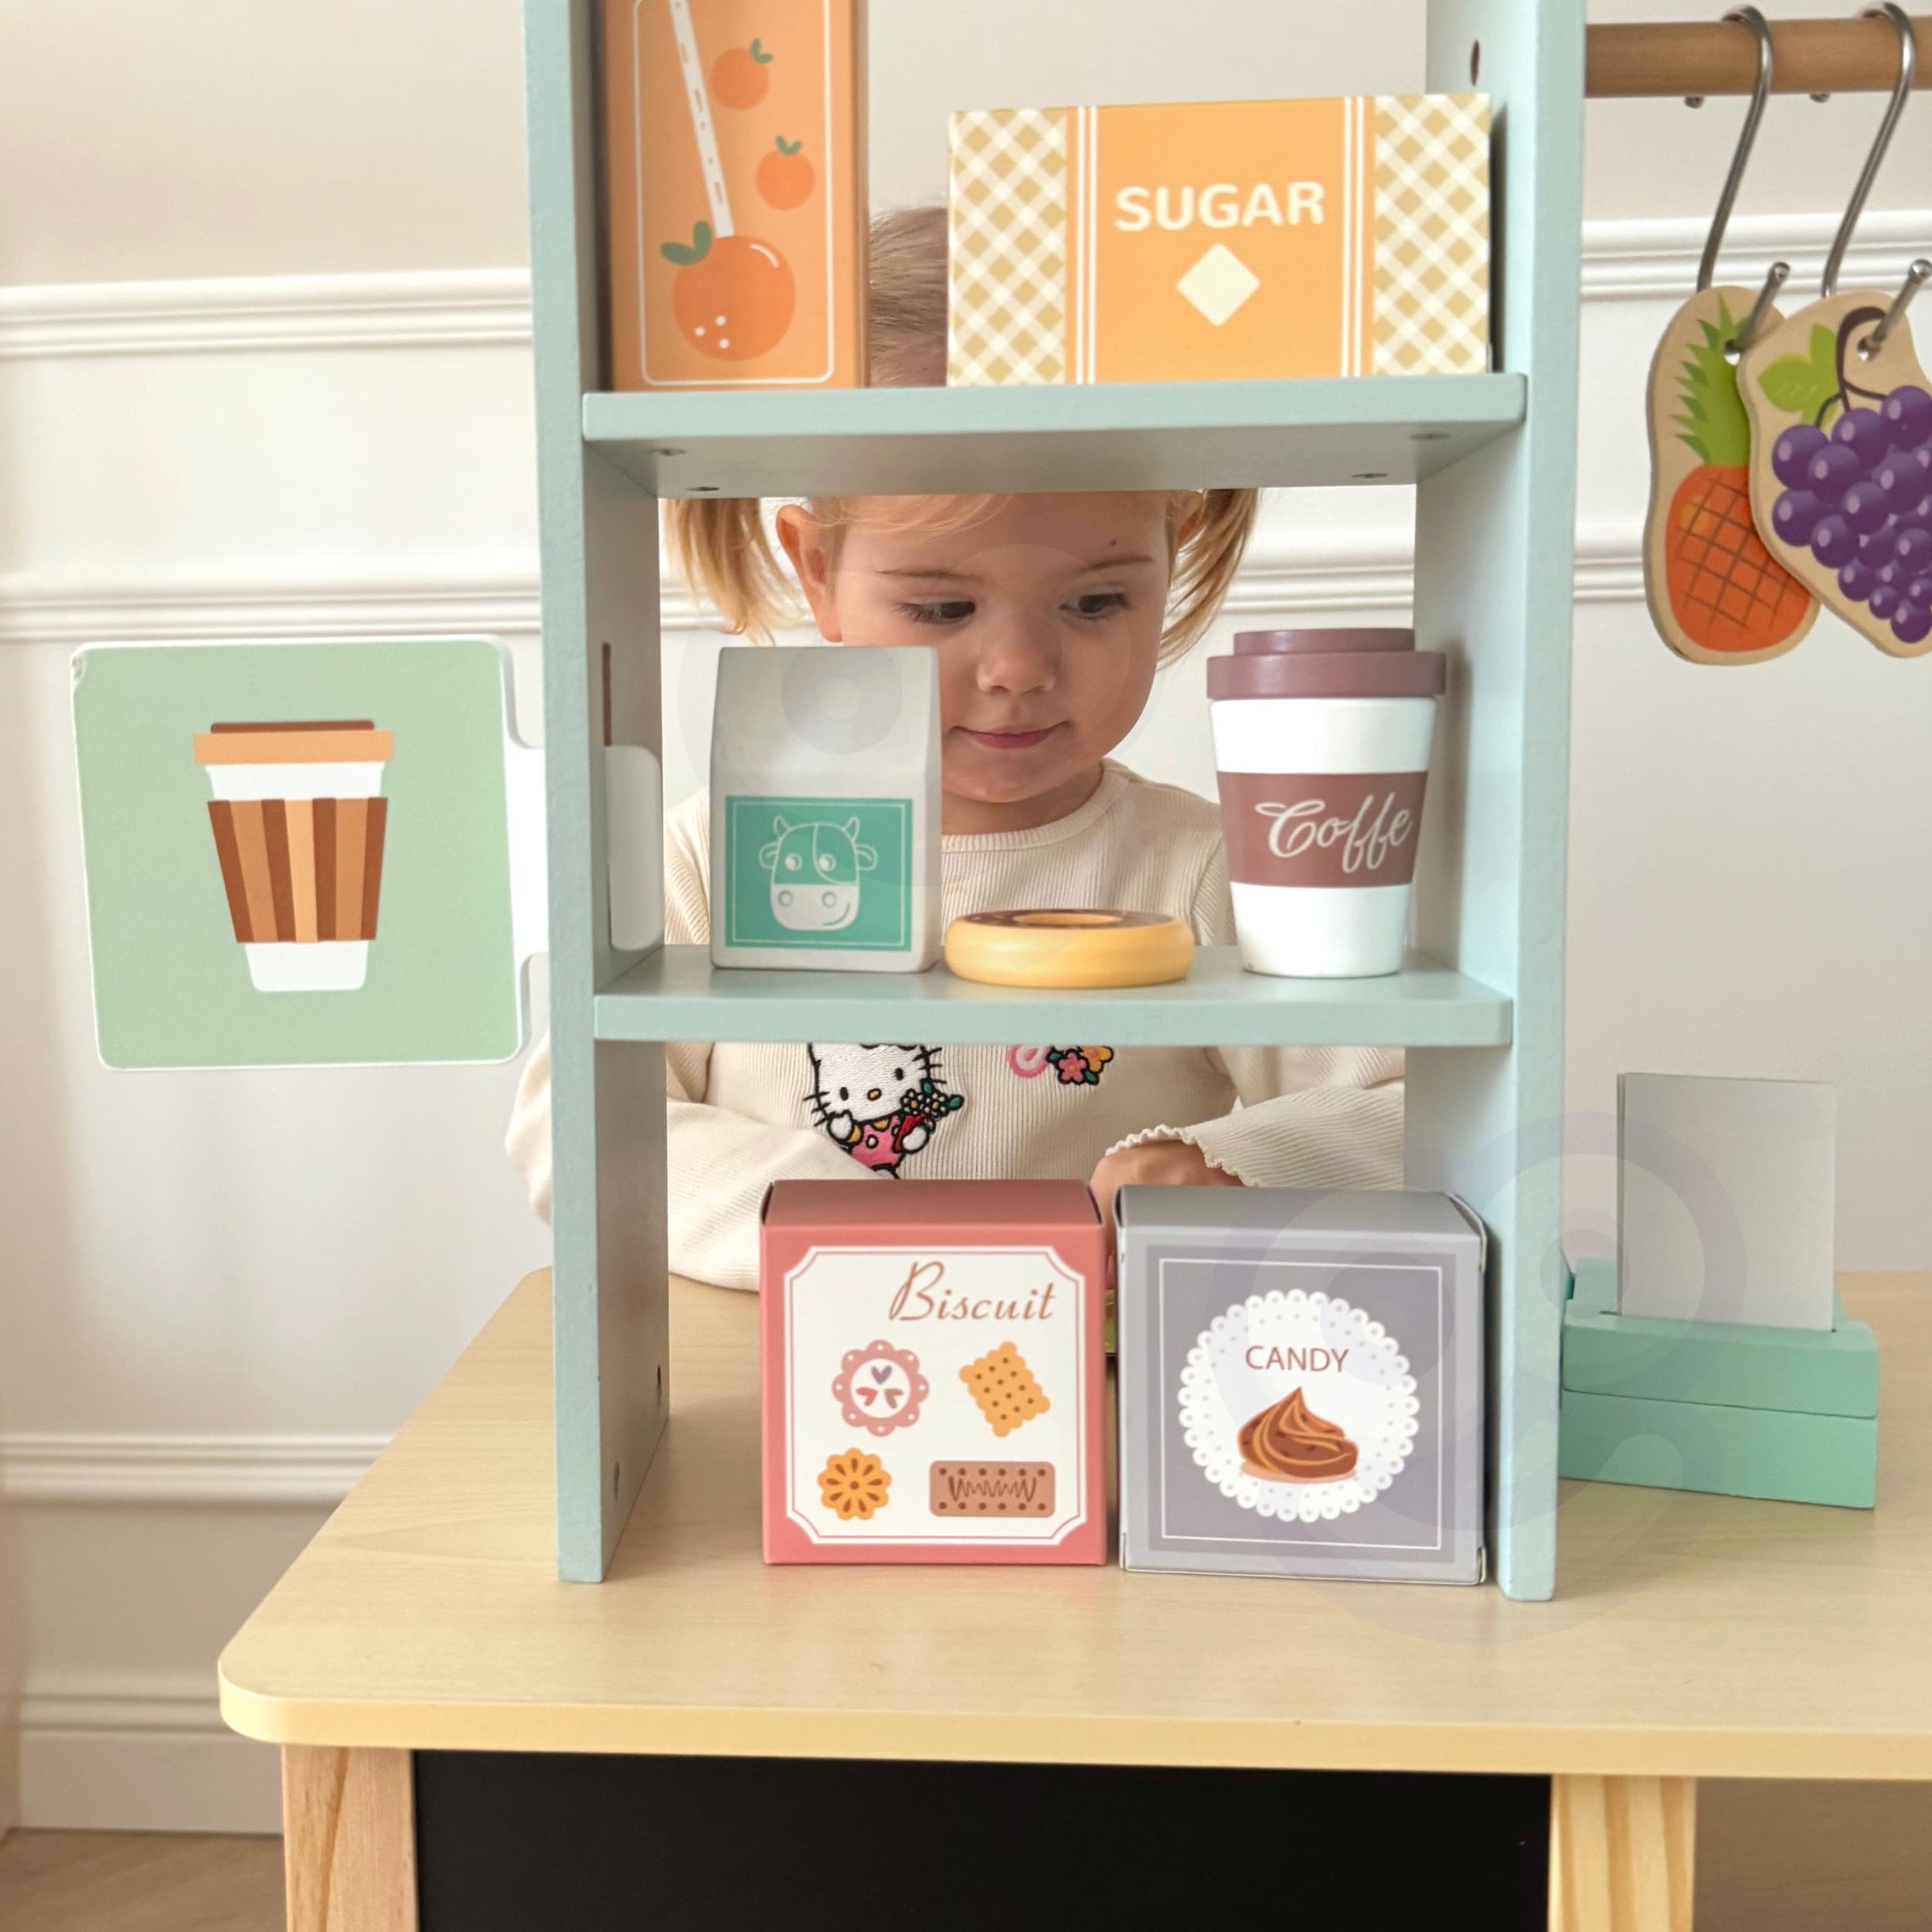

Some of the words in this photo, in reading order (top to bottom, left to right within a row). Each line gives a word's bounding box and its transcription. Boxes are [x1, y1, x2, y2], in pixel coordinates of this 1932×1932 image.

[1114, 181, 1325, 233] SUGAR
[889, 1260, 1057, 1321] Biscuit
[1245, 1345, 1349, 1372] CANDY
